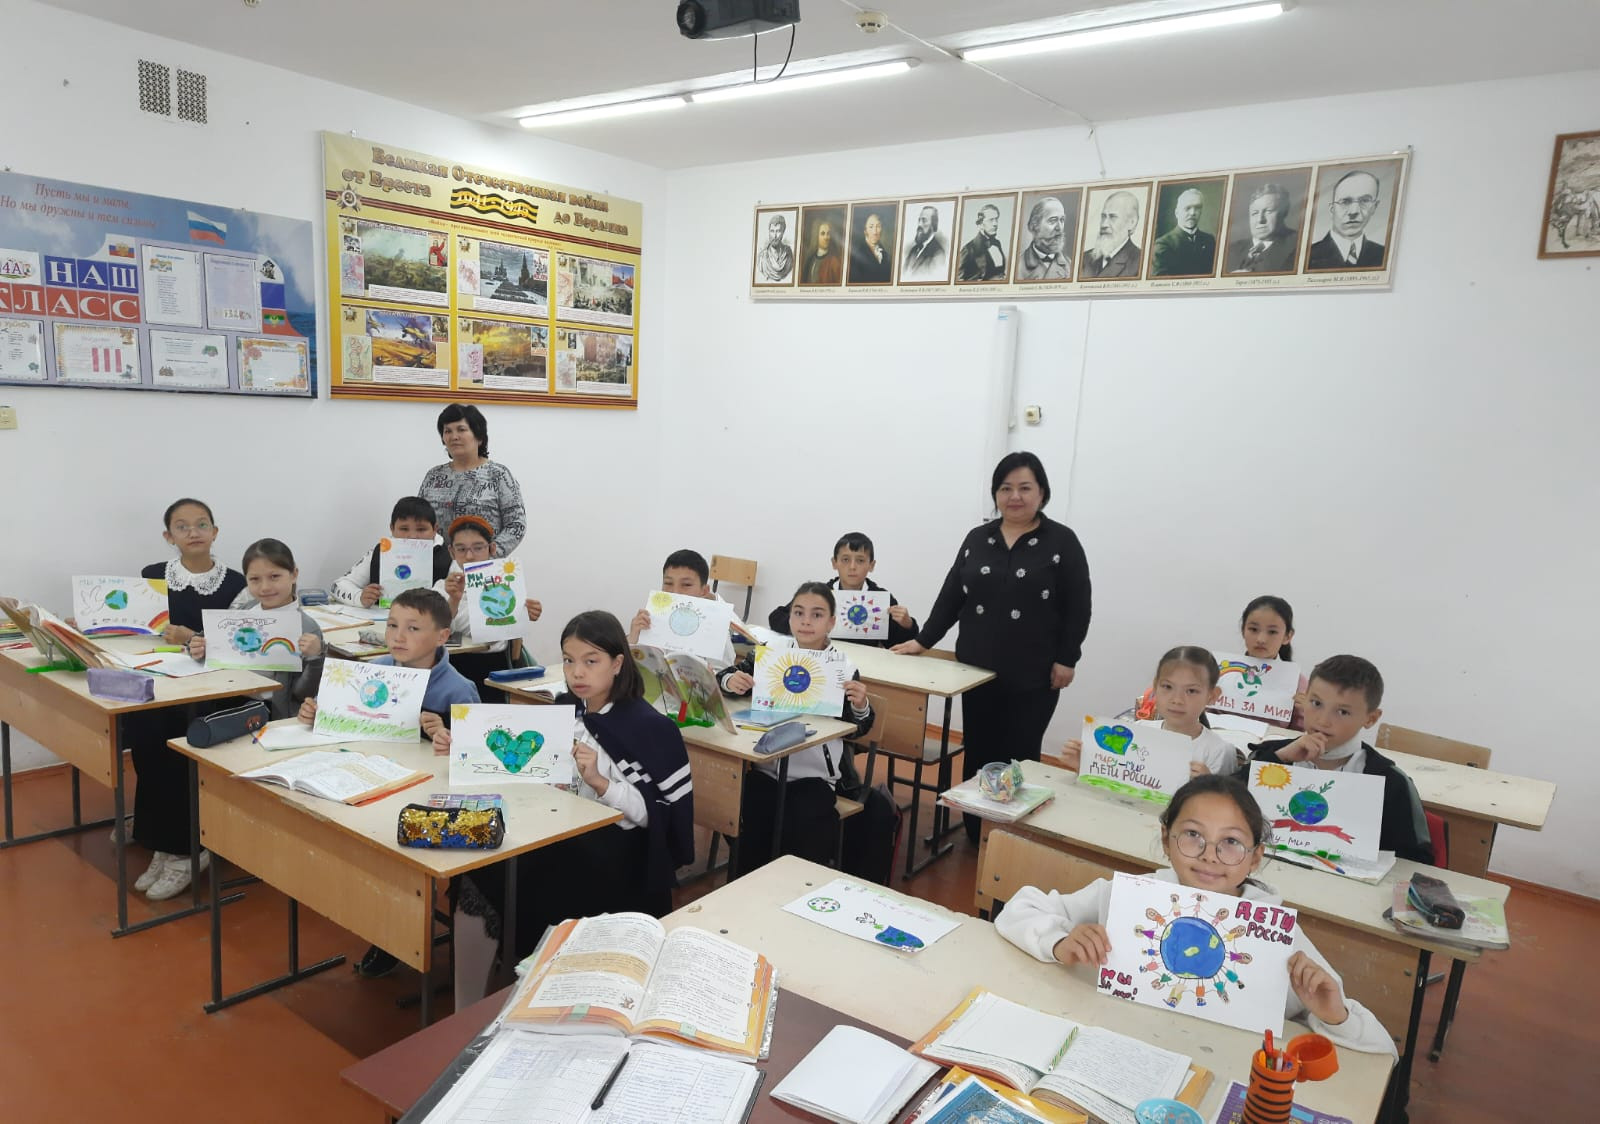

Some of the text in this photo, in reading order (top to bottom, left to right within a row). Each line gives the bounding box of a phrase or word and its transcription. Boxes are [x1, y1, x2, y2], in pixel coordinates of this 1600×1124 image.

[342, 168, 432, 197] от Бреста
[372, 147, 449, 178] Великая
[452, 165, 566, 203] Отечественная
[34, 183, 71, 199] Пусть
[74, 192, 90, 202] мы
[20, 201, 37, 212] мы
[40, 202, 85, 219] дружны
[553, 211, 570, 225] до
[574, 212, 629, 235] Берлина
[49, 261, 137, 289] НАШ
[1214, 696, 1235, 708] МЫ
[1241, 701, 1255, 712] ЗА
[1235, 901, 1295, 945] ДЕТИ РОССИИ
[1101, 968, 1132, 985] МЫ
